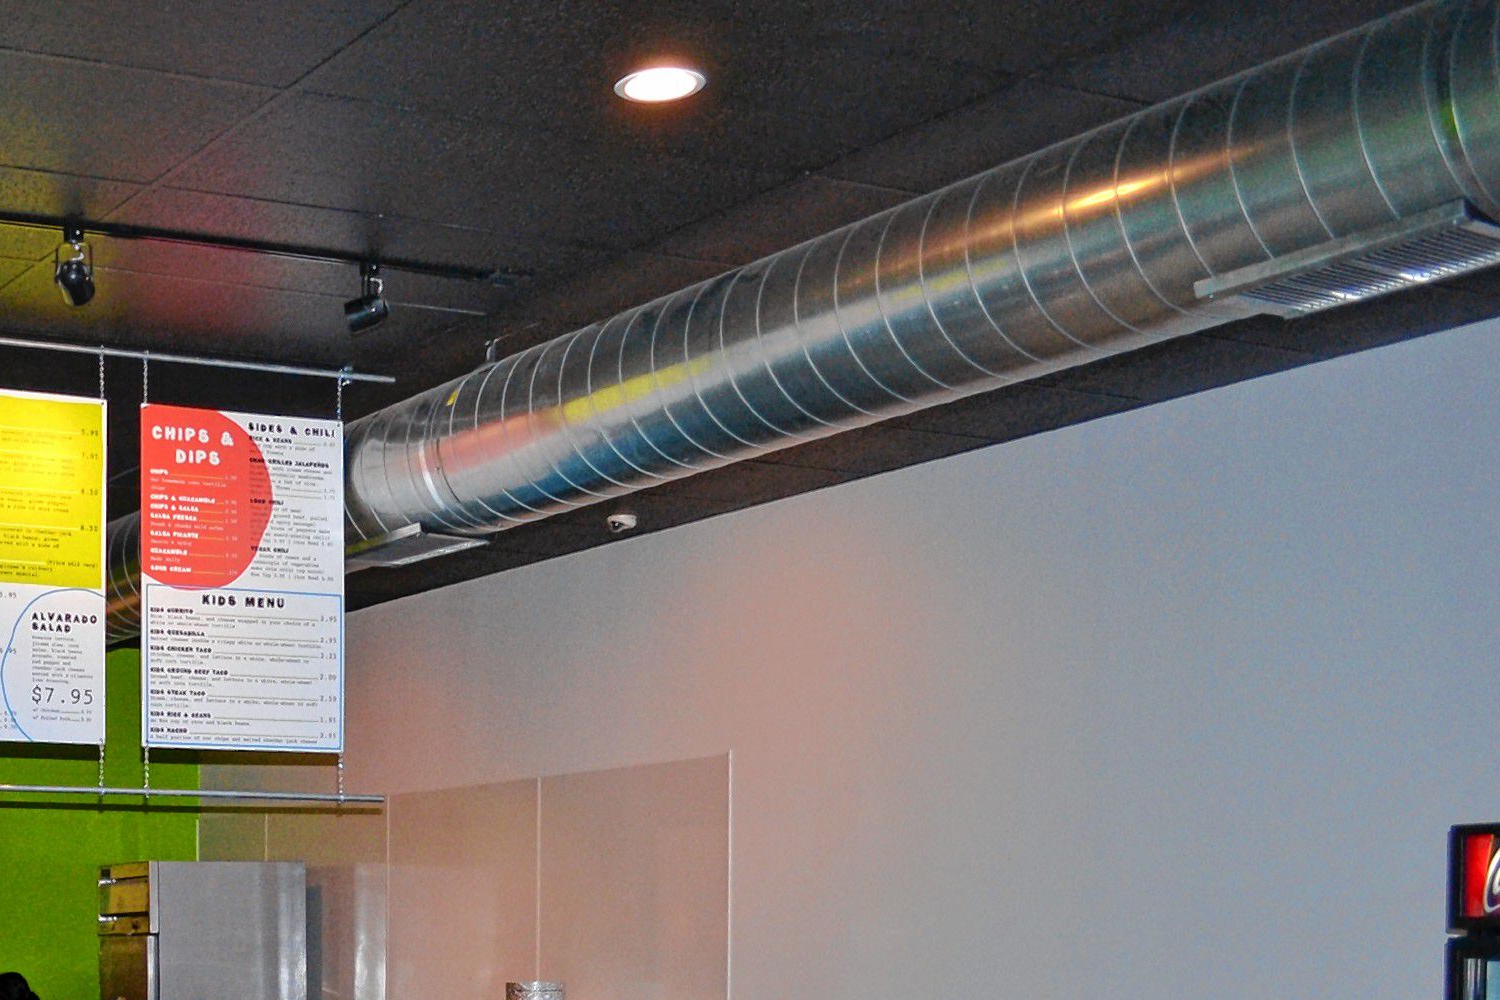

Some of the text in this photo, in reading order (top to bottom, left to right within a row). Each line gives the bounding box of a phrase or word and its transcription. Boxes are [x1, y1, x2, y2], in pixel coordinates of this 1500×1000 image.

[151, 425, 209, 443] CHIPS
[248, 422, 282, 433] SIDES
[305, 427, 335, 438] CHILI
[175, 448, 220, 466] DIPS
[202, 594, 284, 609] KIDS MENU
[32, 611, 97, 624] ALVARADO
[32, 622, 71, 632] SALAD
[31, 684, 93, 706] $7.95
